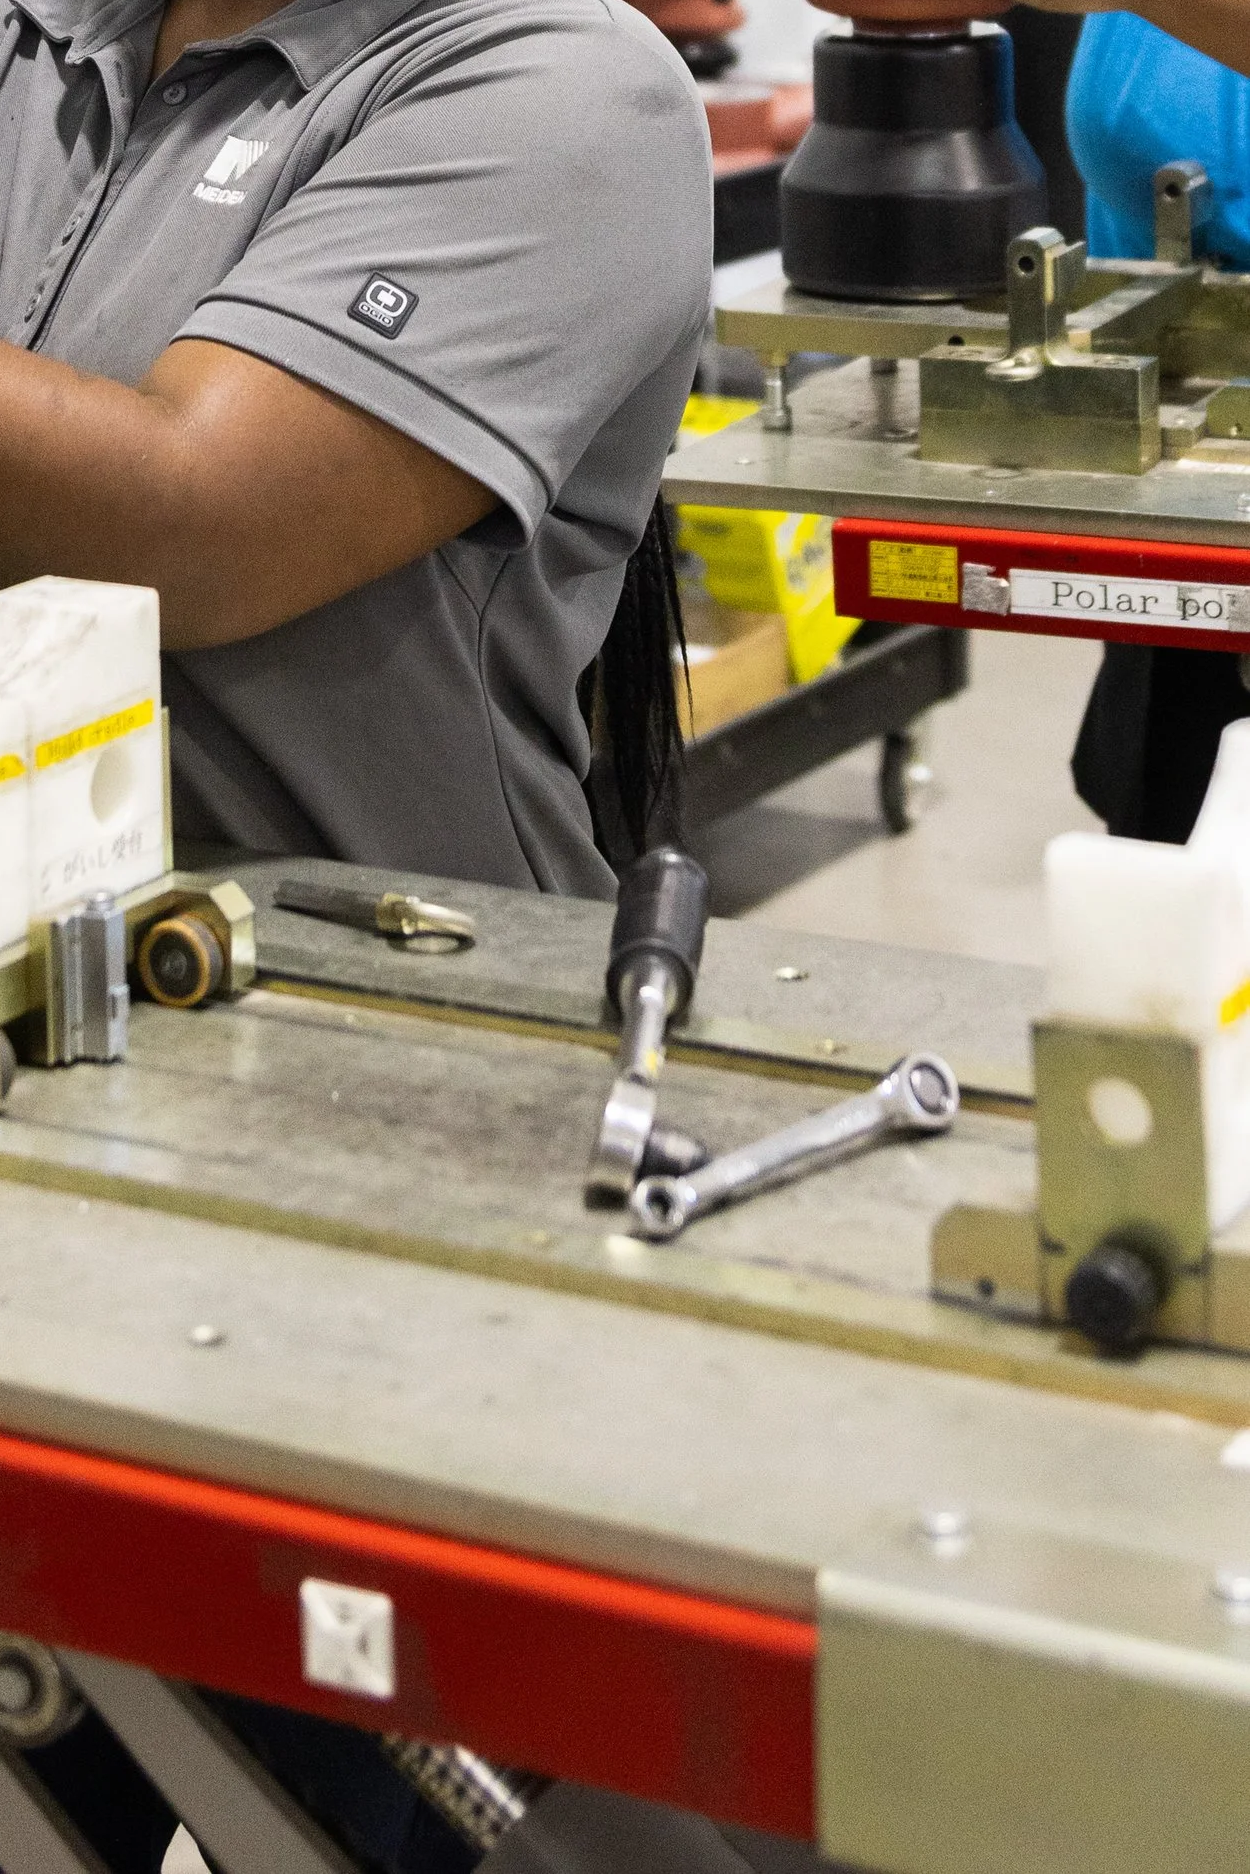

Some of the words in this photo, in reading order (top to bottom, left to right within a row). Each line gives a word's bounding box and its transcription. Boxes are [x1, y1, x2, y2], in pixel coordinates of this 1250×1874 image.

[358, 301, 394, 328] OGIO
[1051, 581, 1159, 614] Polar
[1178, 593, 1236, 621] po
